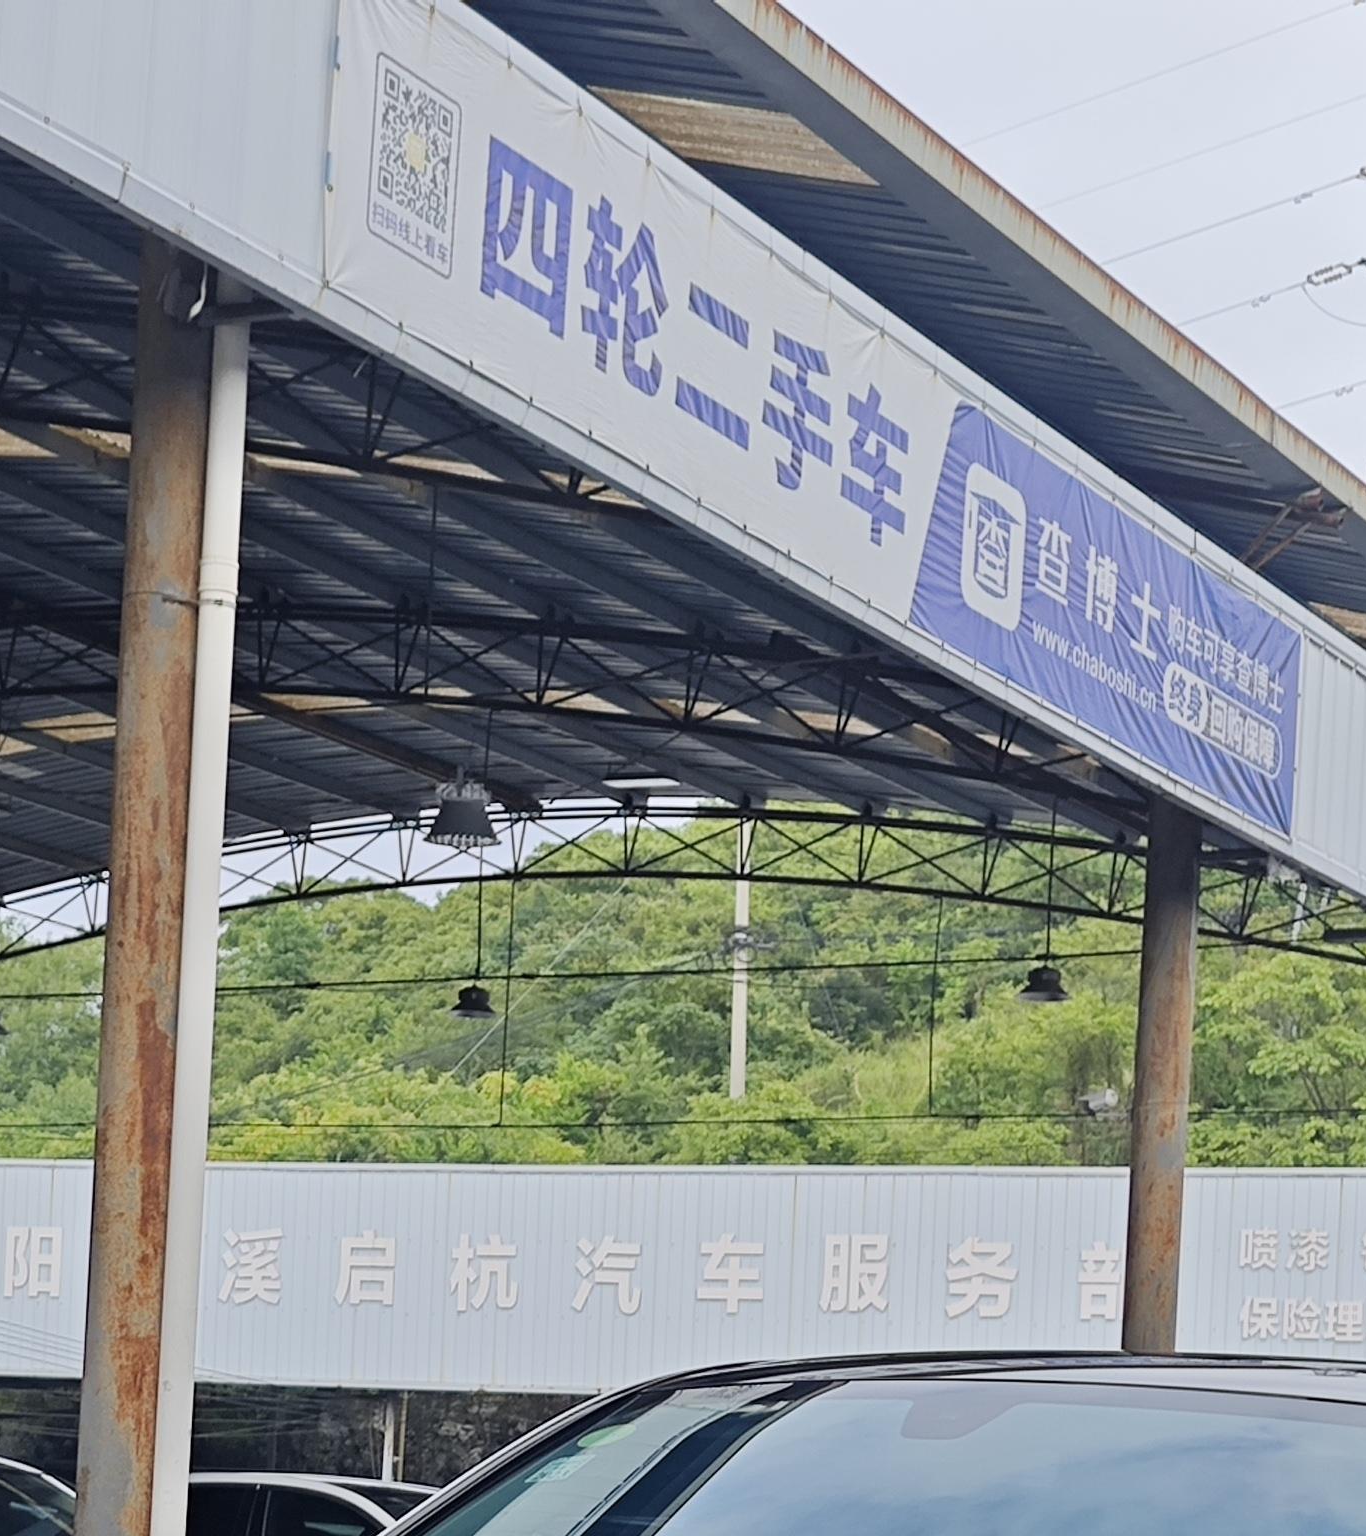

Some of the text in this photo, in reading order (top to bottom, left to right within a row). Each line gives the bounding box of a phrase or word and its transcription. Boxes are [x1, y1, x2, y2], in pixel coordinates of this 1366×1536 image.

[480, 134, 909, 548] 四轮二手车
[1035, 517, 1161, 662] 查博士
[1032, 621, 1158, 713] www.chaboshi.cn
[1167, 604, 1284, 714] 购车可享查博士
[1239, 1227, 1330, 1272] 喷漆
